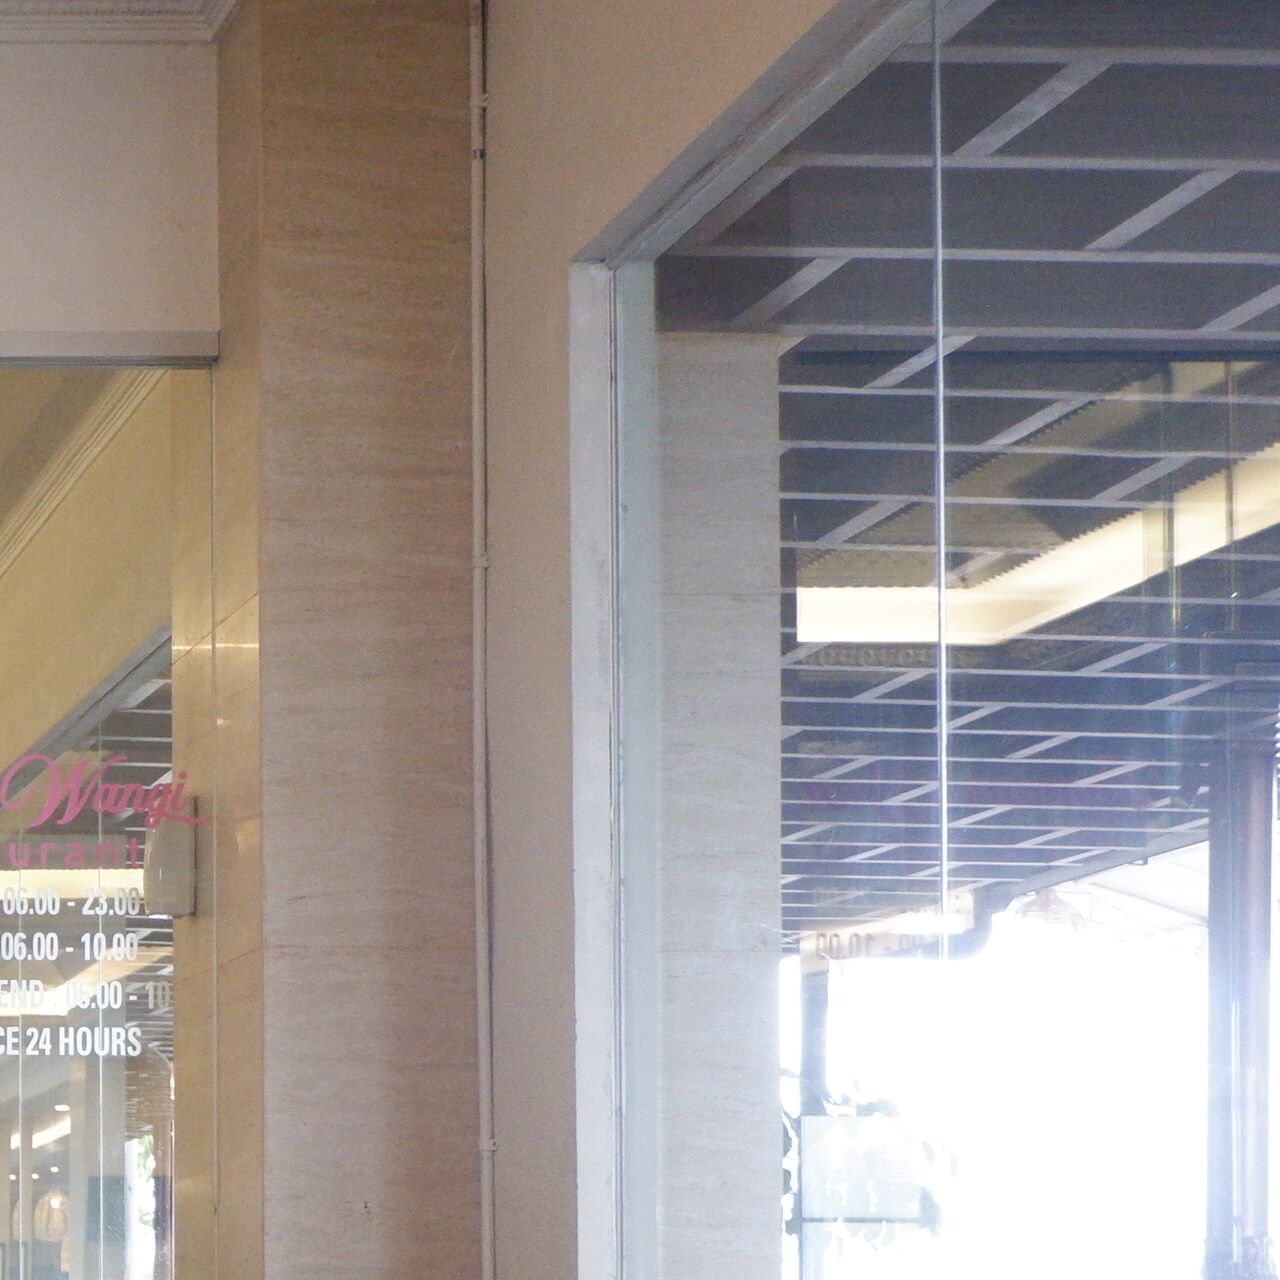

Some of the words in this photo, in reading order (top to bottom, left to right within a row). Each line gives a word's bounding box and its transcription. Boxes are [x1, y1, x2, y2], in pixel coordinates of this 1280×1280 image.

[0, 755, 211, 827] Wangi
[2, 886, 61, 916] 06.00
[81, 886, 142, 916] 23.00
[0, 932, 59, 961] 06.00
[81, 932, 139, 962] 10.00
[25, 1026, 52, 1055] 24
[59, 1026, 142, 1056] HOURS
